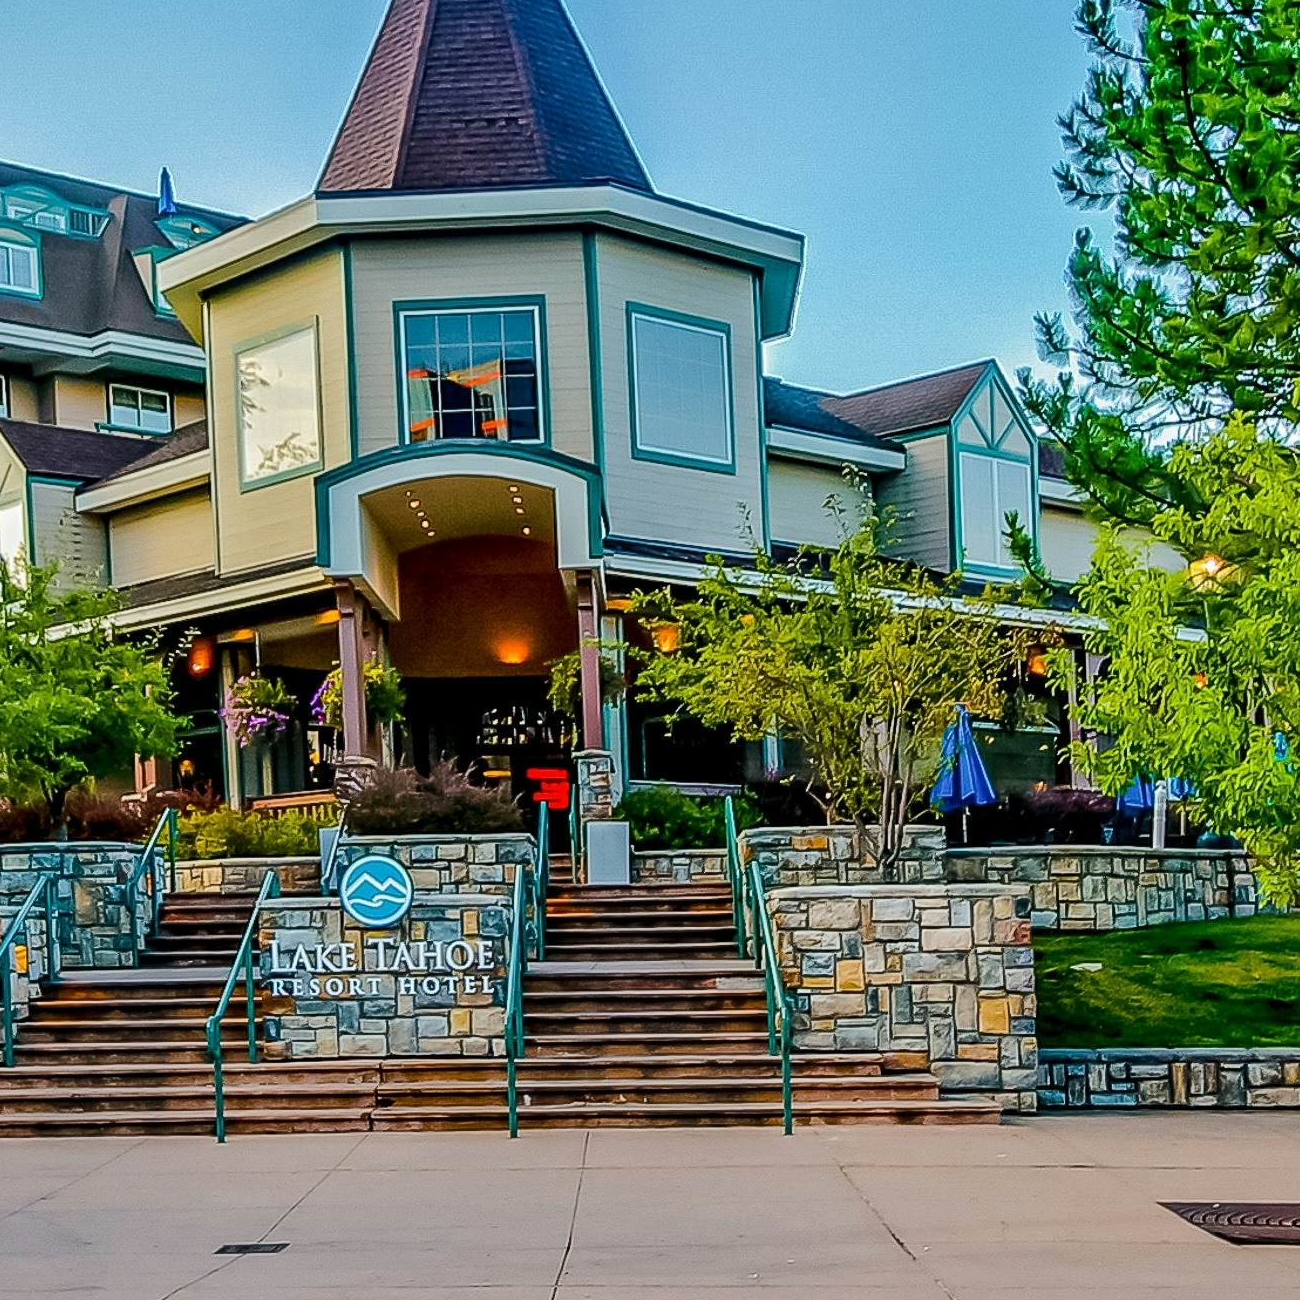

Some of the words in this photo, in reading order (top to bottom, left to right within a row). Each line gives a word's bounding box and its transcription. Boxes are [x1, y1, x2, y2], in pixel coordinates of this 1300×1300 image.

[269, 939, 357, 973] LAKE
[366, 937, 495, 973] TAHOE
[271, 978, 381, 997] RESORT
[400, 975, 495, 995] HOTEL
